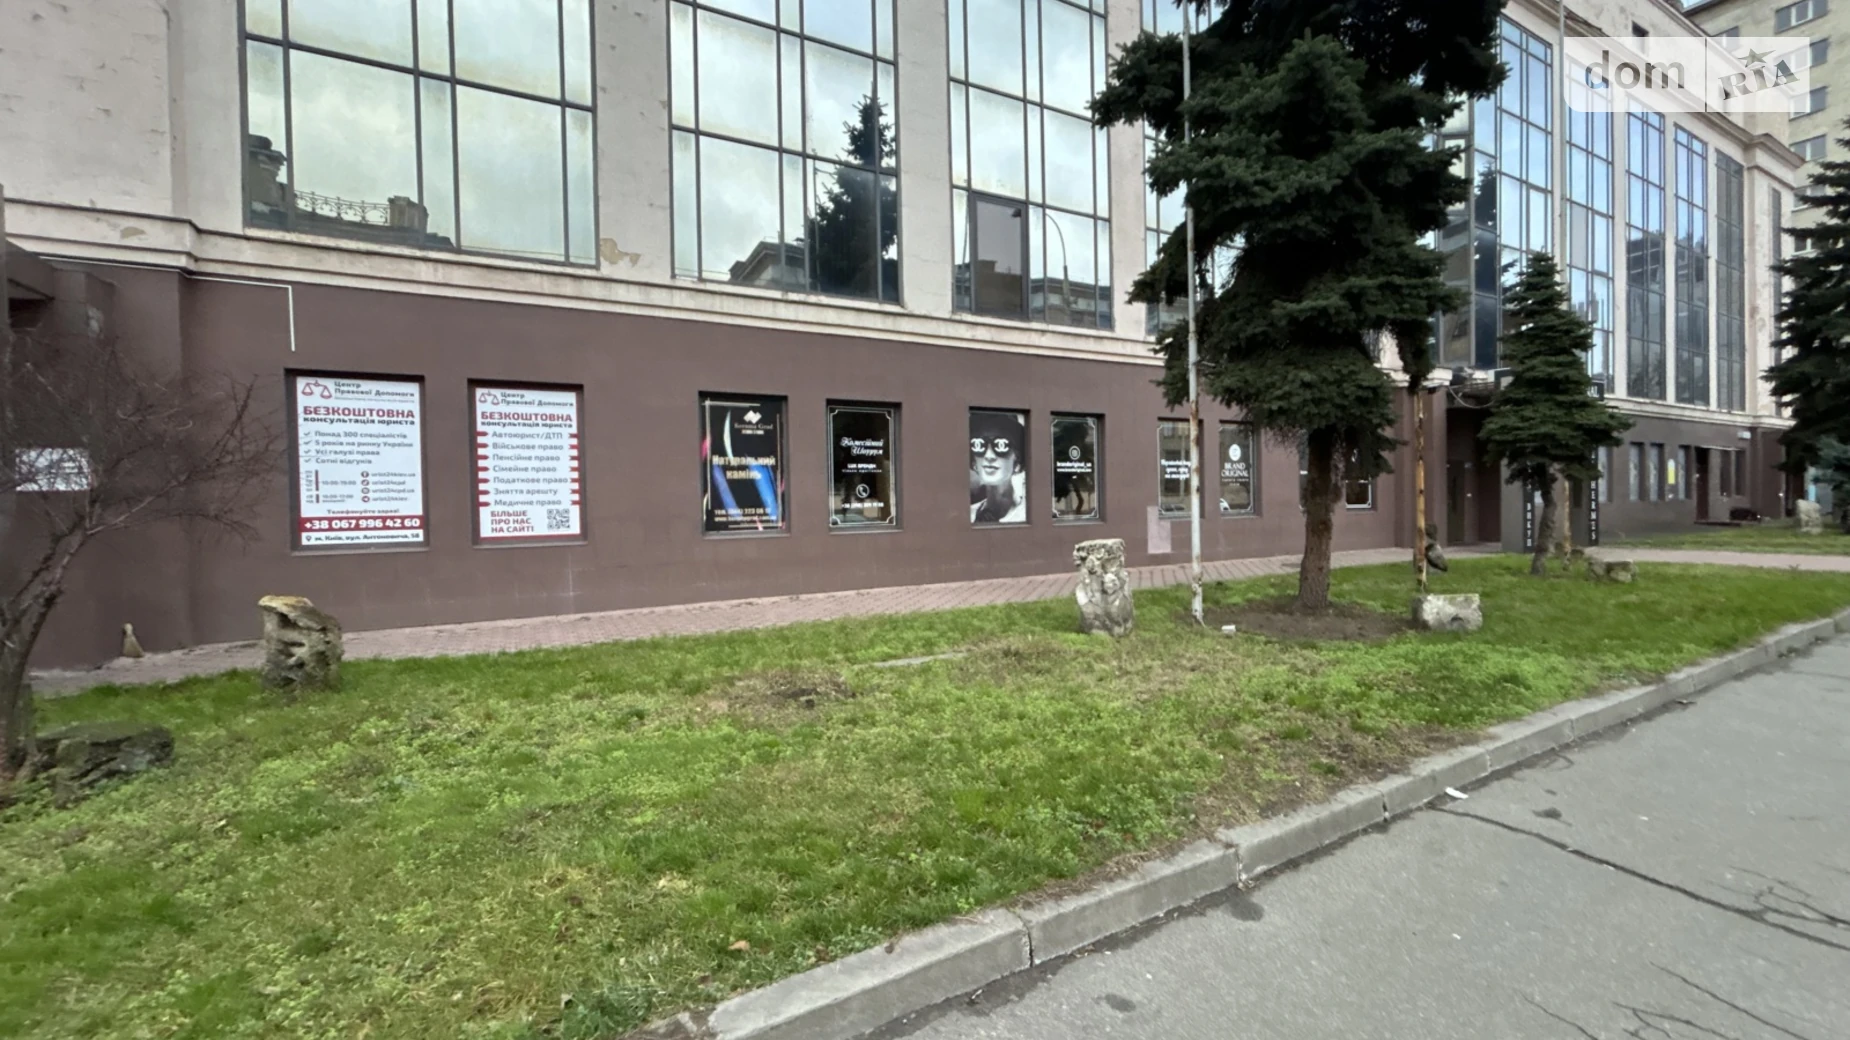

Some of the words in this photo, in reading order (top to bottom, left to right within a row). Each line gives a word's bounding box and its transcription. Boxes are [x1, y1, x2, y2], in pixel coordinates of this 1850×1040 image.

[334, 388, 372, 396] Правової
[303, 406, 415, 418] БЕЗКОШТОВНА
[481, 411, 572, 422] БЕЗКОШТОВНА
[303, 416, 375, 425] консультація
[492, 431, 563, 440] Автоюрист/ДТП
[492, 442, 536, 450] Військове
[712, 455, 776, 466] Натуральний
[1224, 462, 1246, 470] BRAND
[726, 469, 762, 479] камінь
[1221, 469, 1248, 477] ORIGINAL
[494, 499, 534, 507] Медичне
[304, 520, 329, 529] +38
[331, 519, 356, 528] 067
[358, 519, 383, 528] 996
[385, 518, 402, 527] 42
[404, 518, 420, 527] 60
[506, 525, 534, 533] САЙТІ
